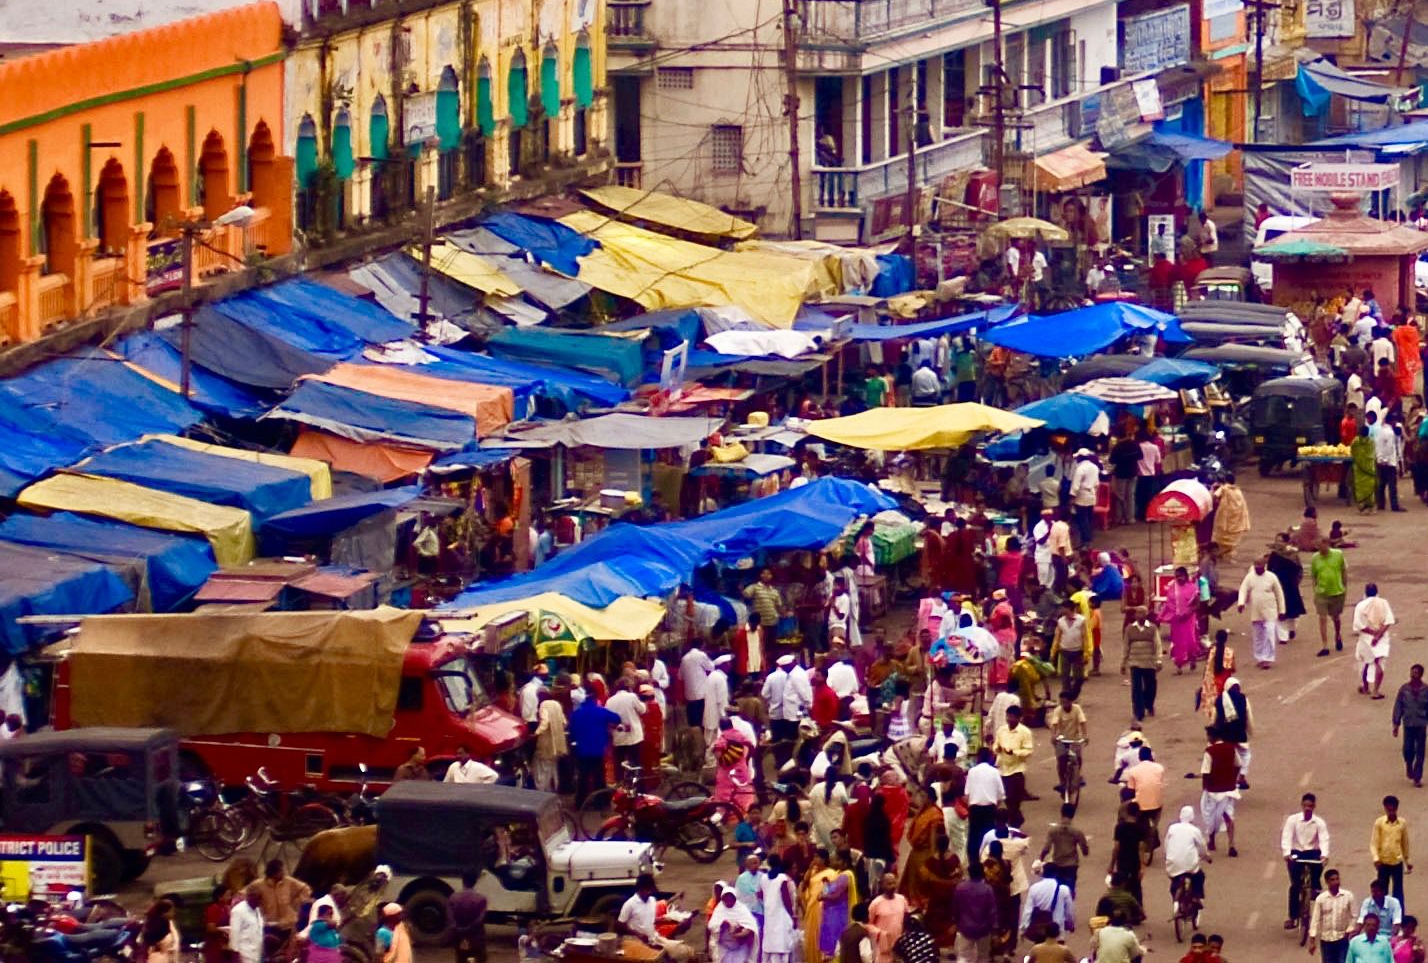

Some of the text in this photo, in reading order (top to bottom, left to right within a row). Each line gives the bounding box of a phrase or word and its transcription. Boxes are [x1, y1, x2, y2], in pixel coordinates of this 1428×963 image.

[1294, 173, 1313, 187] FREE
[1314, 173, 1346, 188] MOBILE
[1347, 173, 1380, 188] STAND
[37, 841, 80, 855] POLICE
